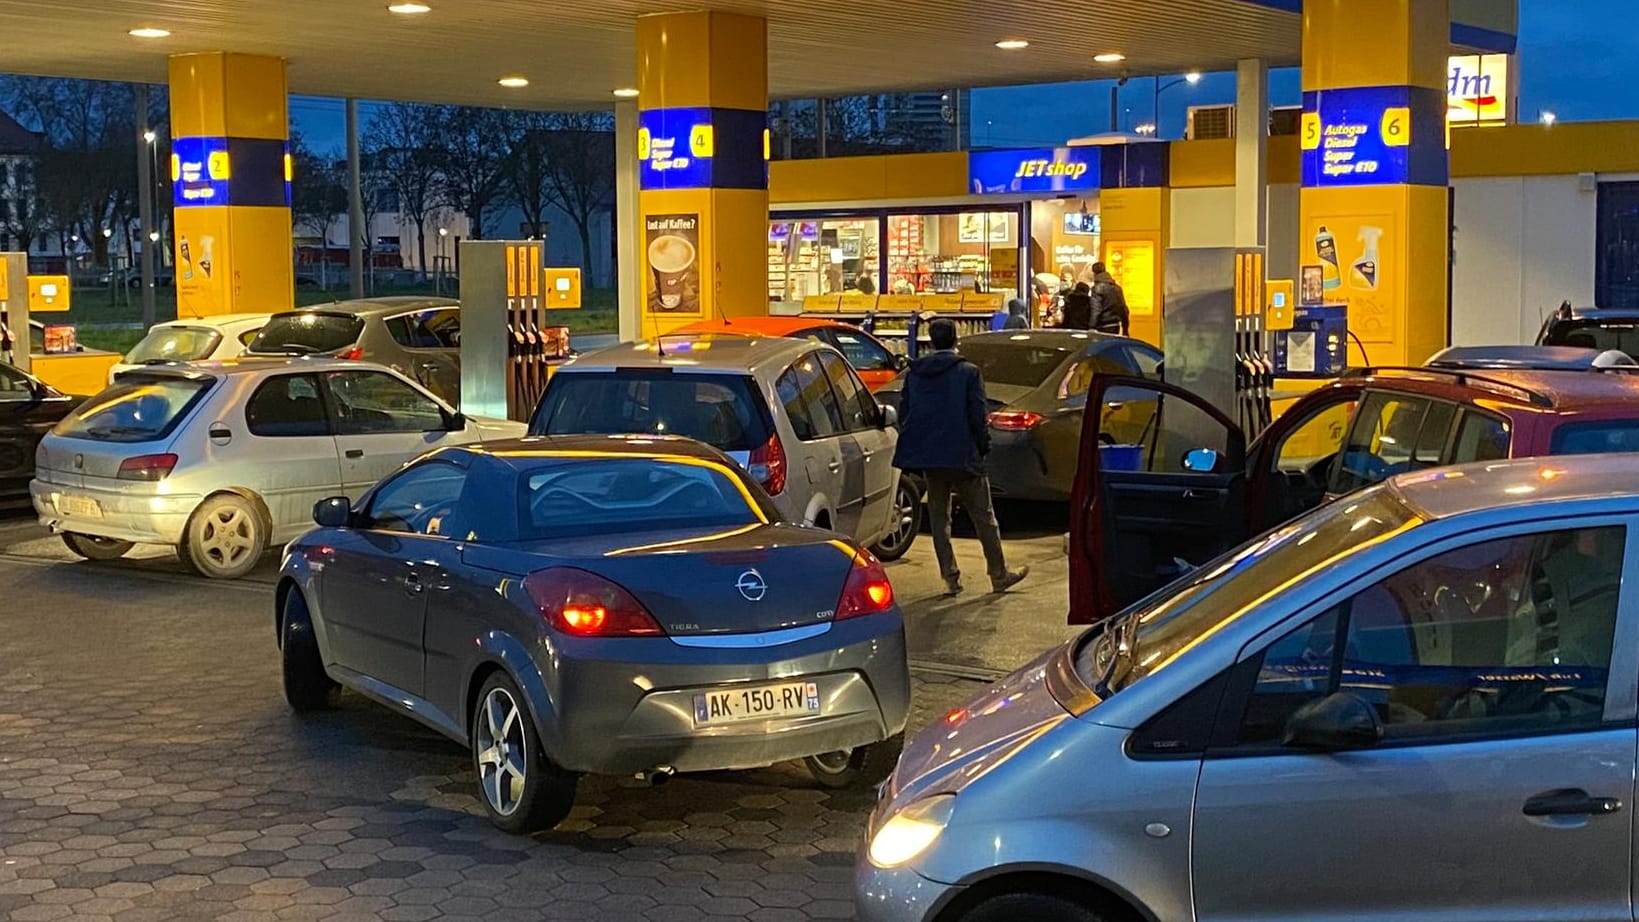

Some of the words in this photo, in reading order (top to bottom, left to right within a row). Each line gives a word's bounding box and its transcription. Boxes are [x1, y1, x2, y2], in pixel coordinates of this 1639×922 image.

[1448, 66, 1491, 95] dm
[1307, 122, 1315, 140] 5
[1324, 124, 1368, 137] Autogas
[1388, 118, 1400, 136] 6
[695, 134, 705, 148] 4
[1324, 136, 1358, 148] Diesel
[1323, 150, 1355, 163] Super
[214, 160, 222, 172] 2
[1015, 159, 1048, 178] JET
[1046, 159, 1087, 180] shop
[1323, 163, 1354, 176] Super
[1354, 160, 1378, 172] E10
[647, 219, 658, 230] Lust
[659, 219, 669, 230] auf
[669, 218, 696, 230] Kaffee?
